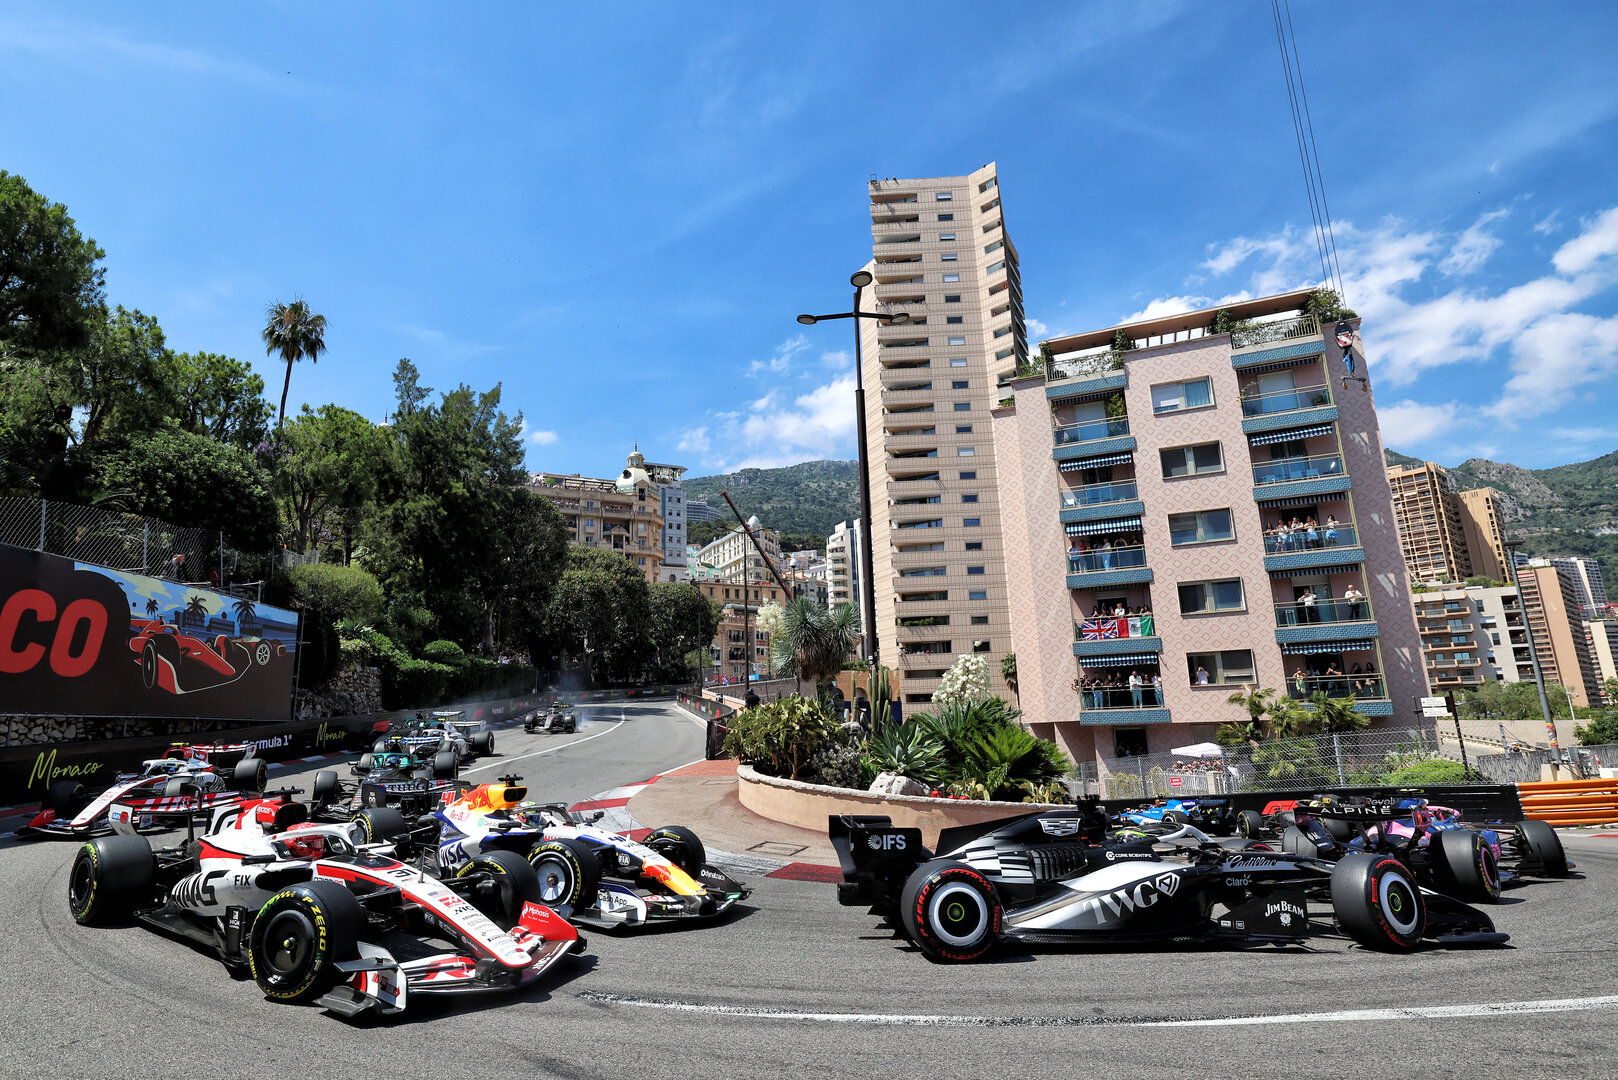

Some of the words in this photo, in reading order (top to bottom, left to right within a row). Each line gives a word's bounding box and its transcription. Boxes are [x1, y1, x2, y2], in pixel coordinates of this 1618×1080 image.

[0, 588, 108, 678] CO
[315, 721, 348, 749] Monaco
[28, 748, 104, 791] Monaco
[440, 790, 456, 808] 41
[1320, 807, 1392, 815] ALPINE
[534, 844, 563, 854] ZERO
[882, 834, 907, 850] IFS
[440, 842, 471, 867] VISA
[1226, 855, 1278, 869] Cadillac
[234, 874, 252, 886] FIX
[387, 868, 418, 878] 31
[1226, 876, 1250, 887] Claro
[598, 892, 613, 903] Cash
[614, 896, 627, 907] App
[916, 884, 931, 926] ZERO
[1082, 880, 1159, 925] TWG
[529, 905, 550, 919] Mphasis
[1265, 903, 1281, 917] JIM
[1281, 900, 1305, 919] BEAM
[302, 896, 314, 904] P
[311, 904, 328, 952] ZERO
